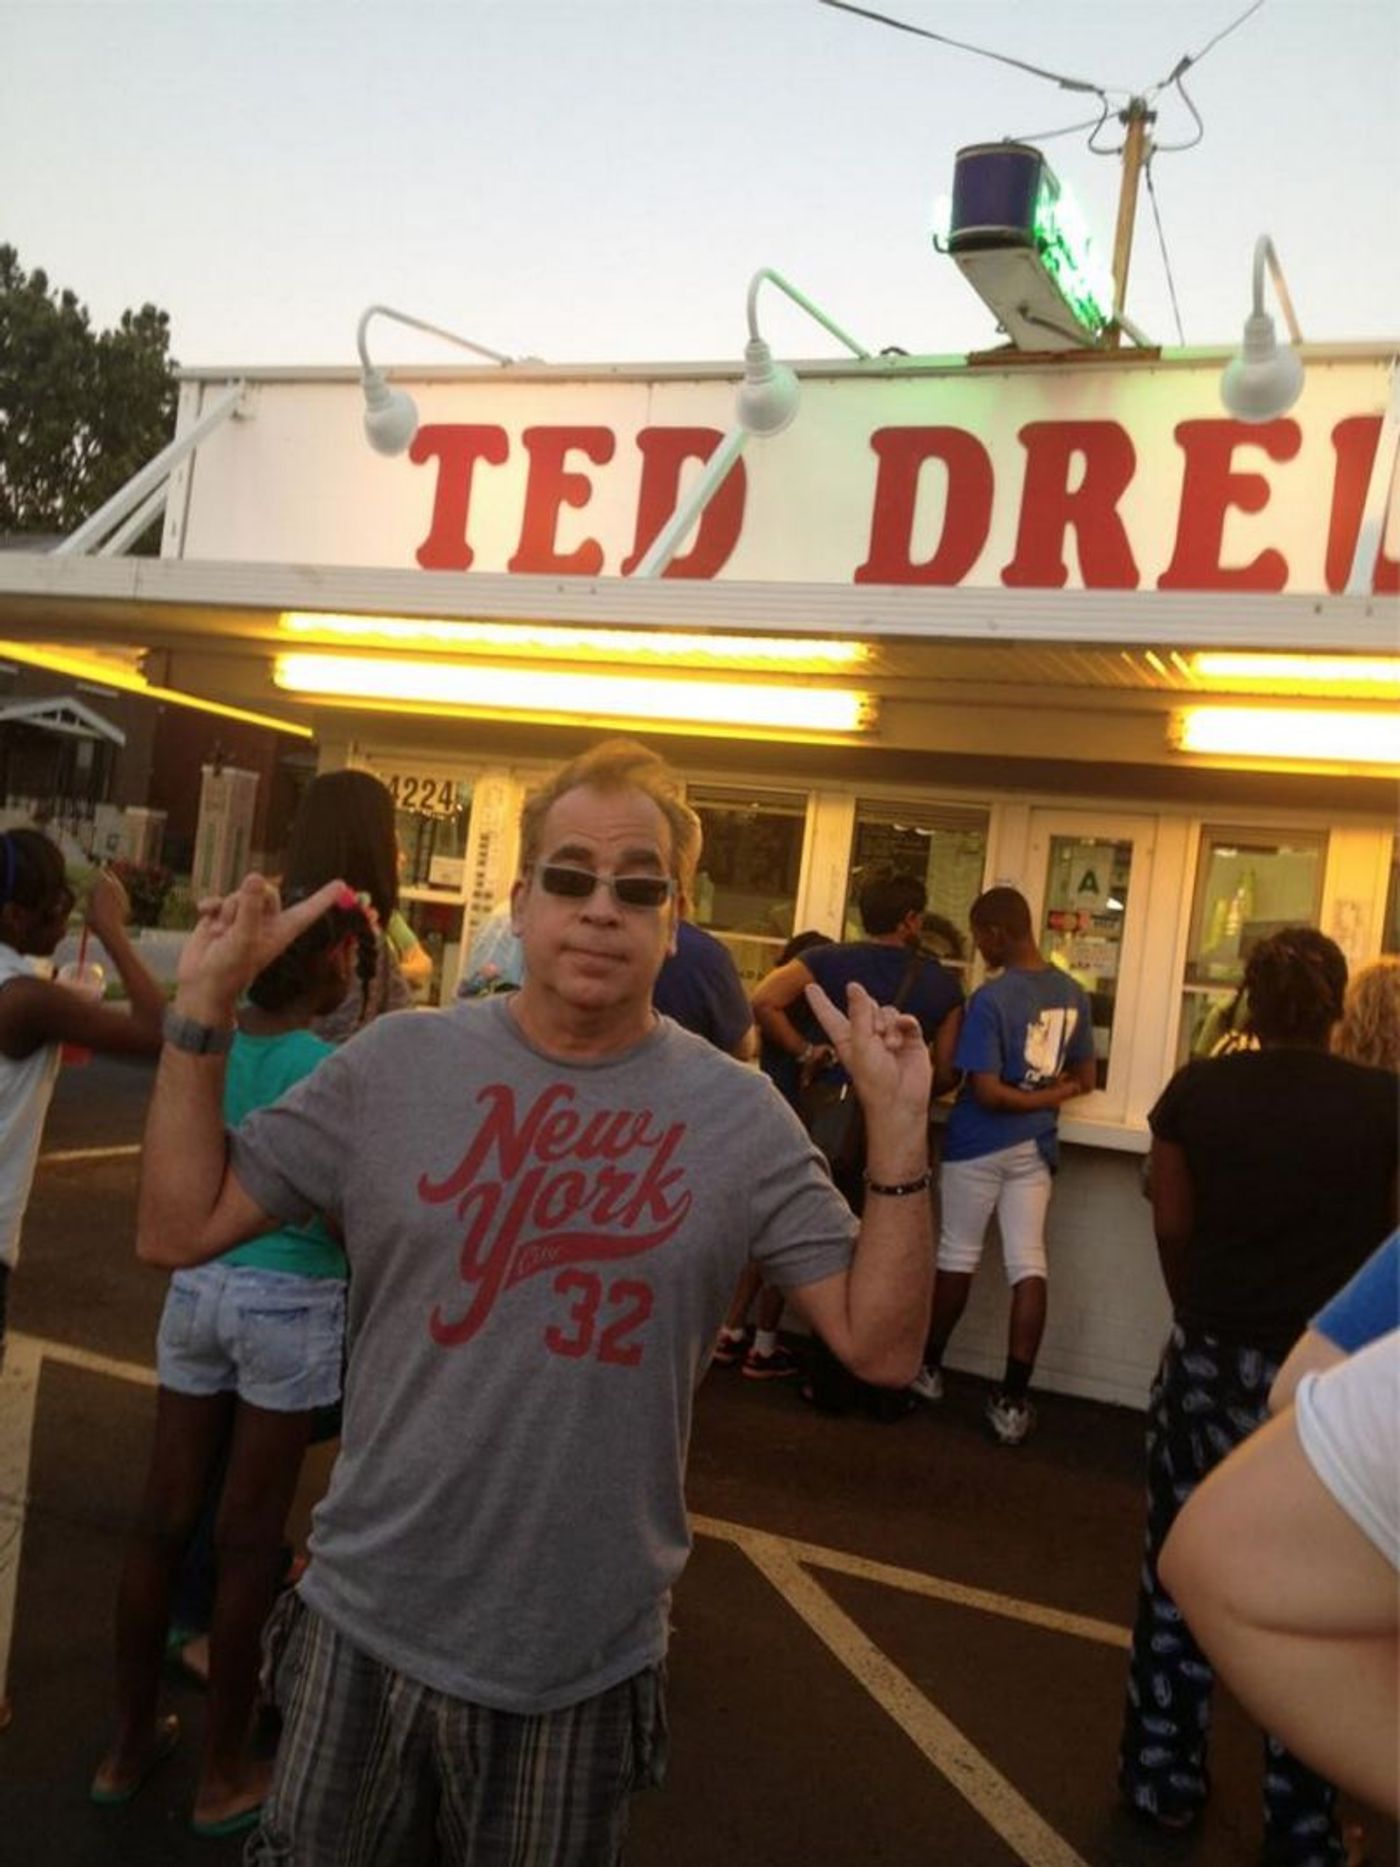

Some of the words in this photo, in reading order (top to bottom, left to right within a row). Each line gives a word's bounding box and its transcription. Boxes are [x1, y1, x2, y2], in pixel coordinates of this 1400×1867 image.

[409, 424, 746, 579] TED
[1078, 869, 1100, 893] A
[418, 1083, 663, 1204] New
[430, 1122, 688, 1346] York
[545, 1269, 654, 1366] 32
